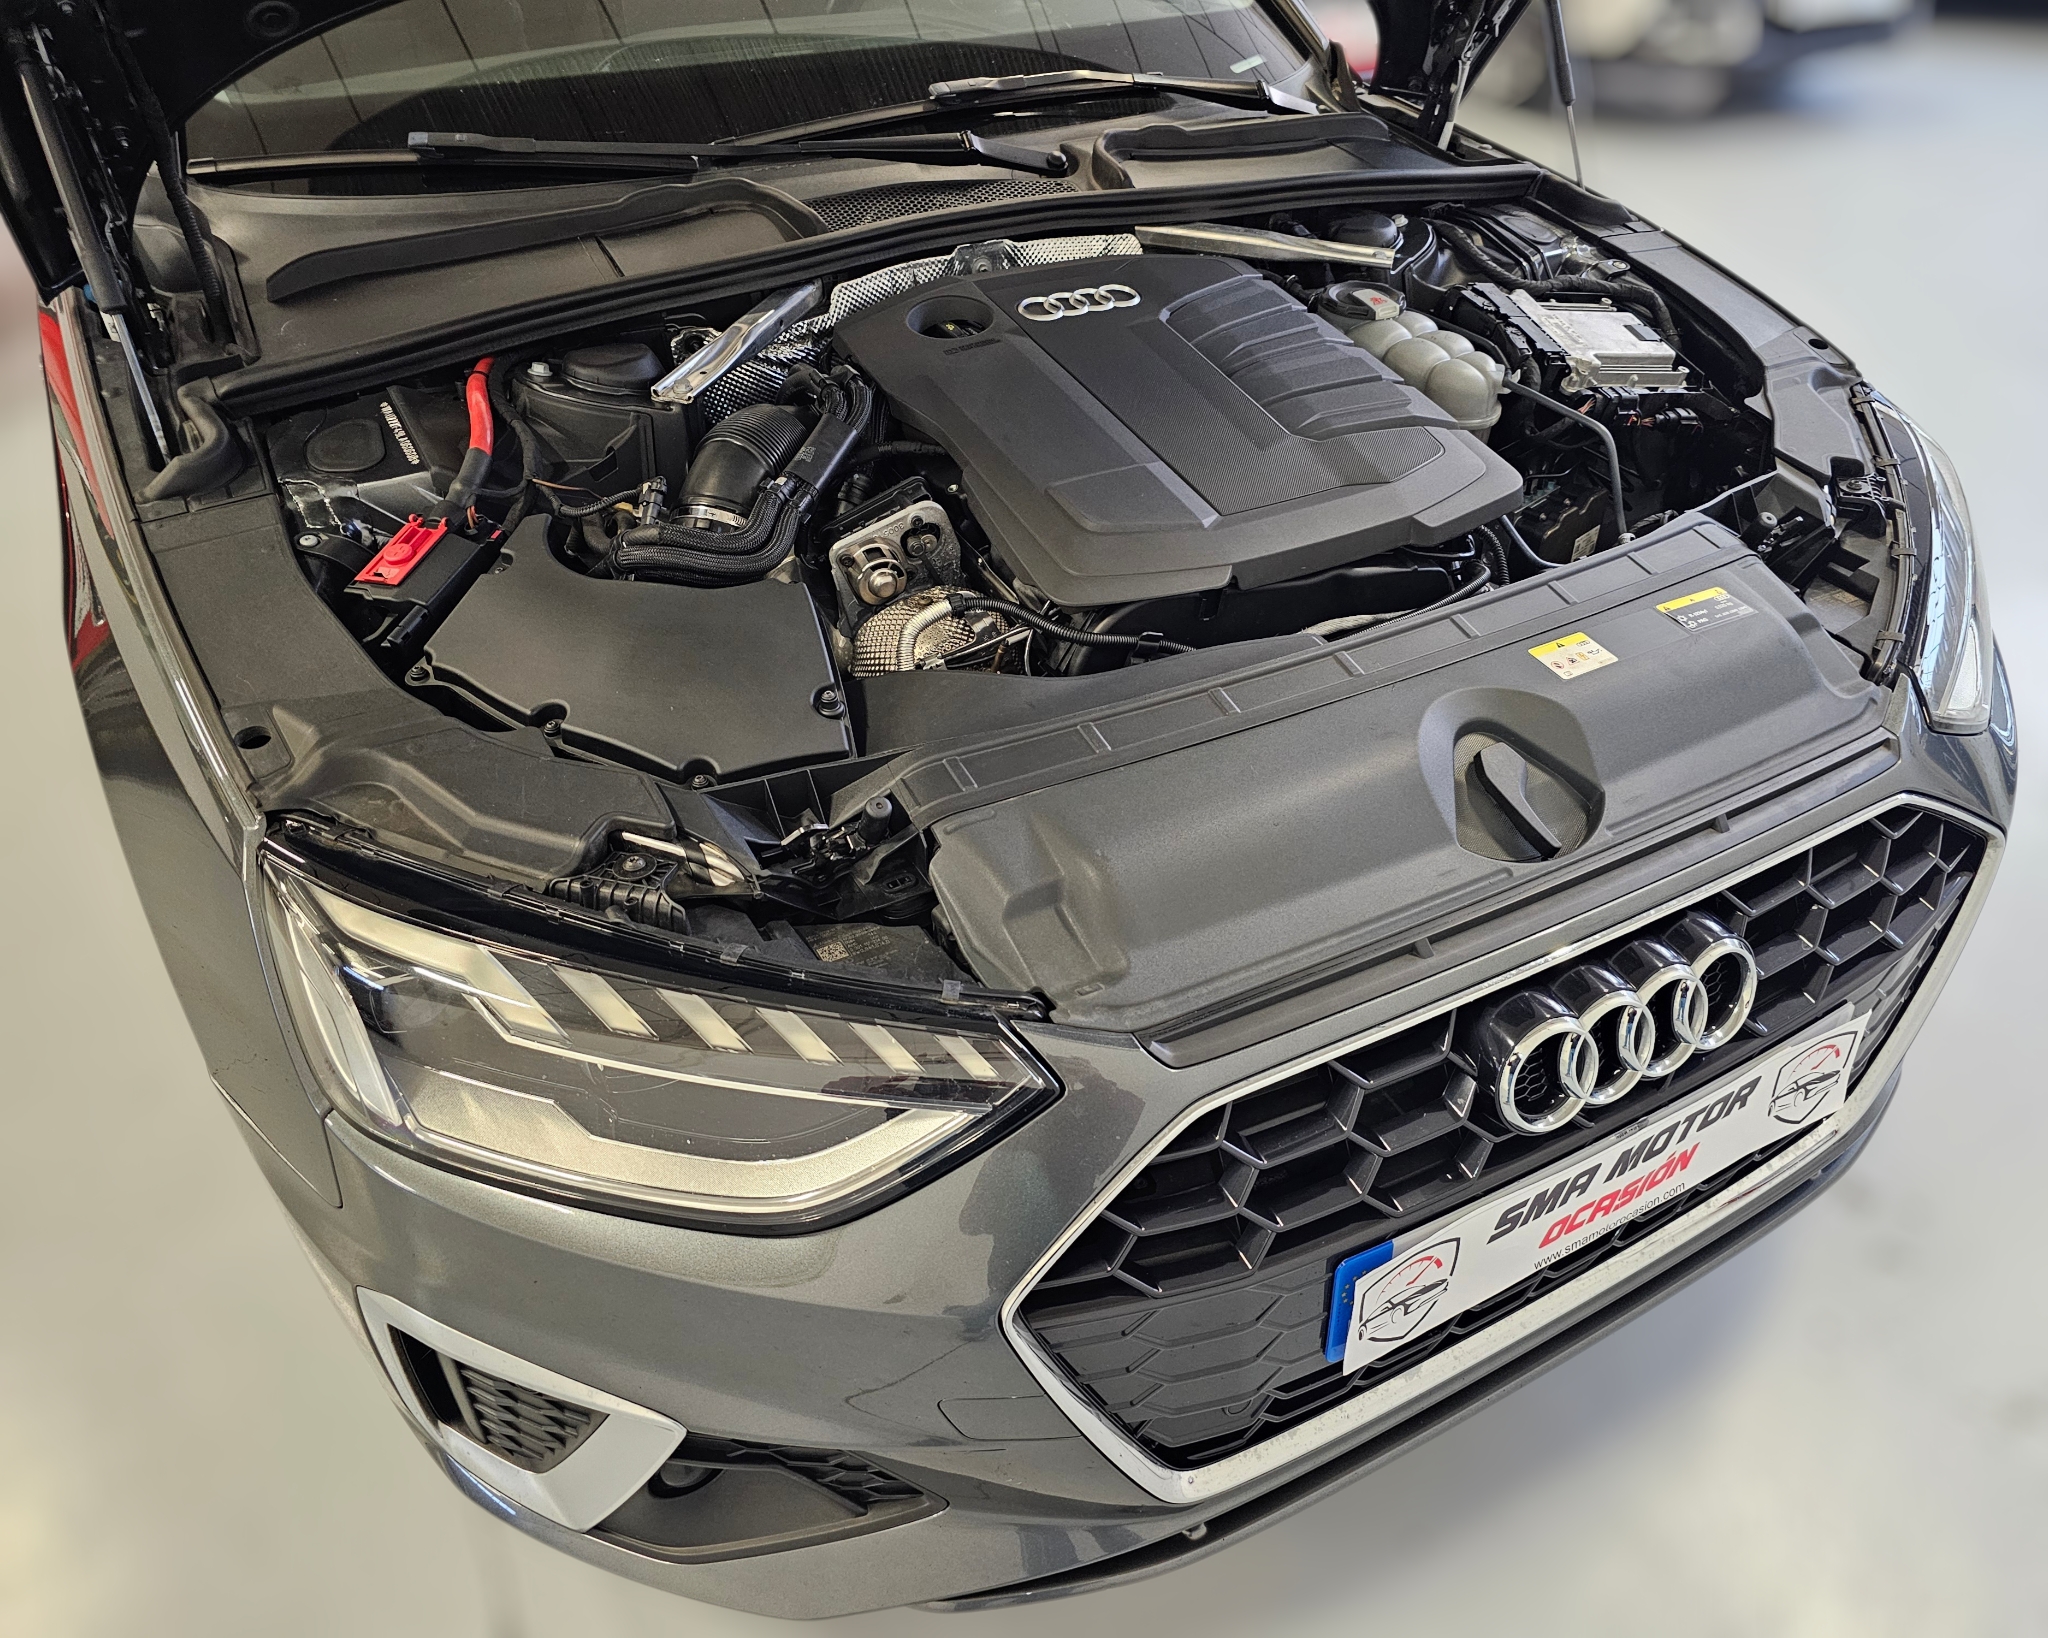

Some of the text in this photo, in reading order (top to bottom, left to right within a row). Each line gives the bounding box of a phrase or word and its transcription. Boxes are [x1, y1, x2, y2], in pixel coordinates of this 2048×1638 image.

[1486, 1075, 1763, 1246] SMA MOTOR
[1538, 1141, 1701, 1249] OCASIÓN
[1533, 1182, 1685, 1270] www.smamotorocasion.com
